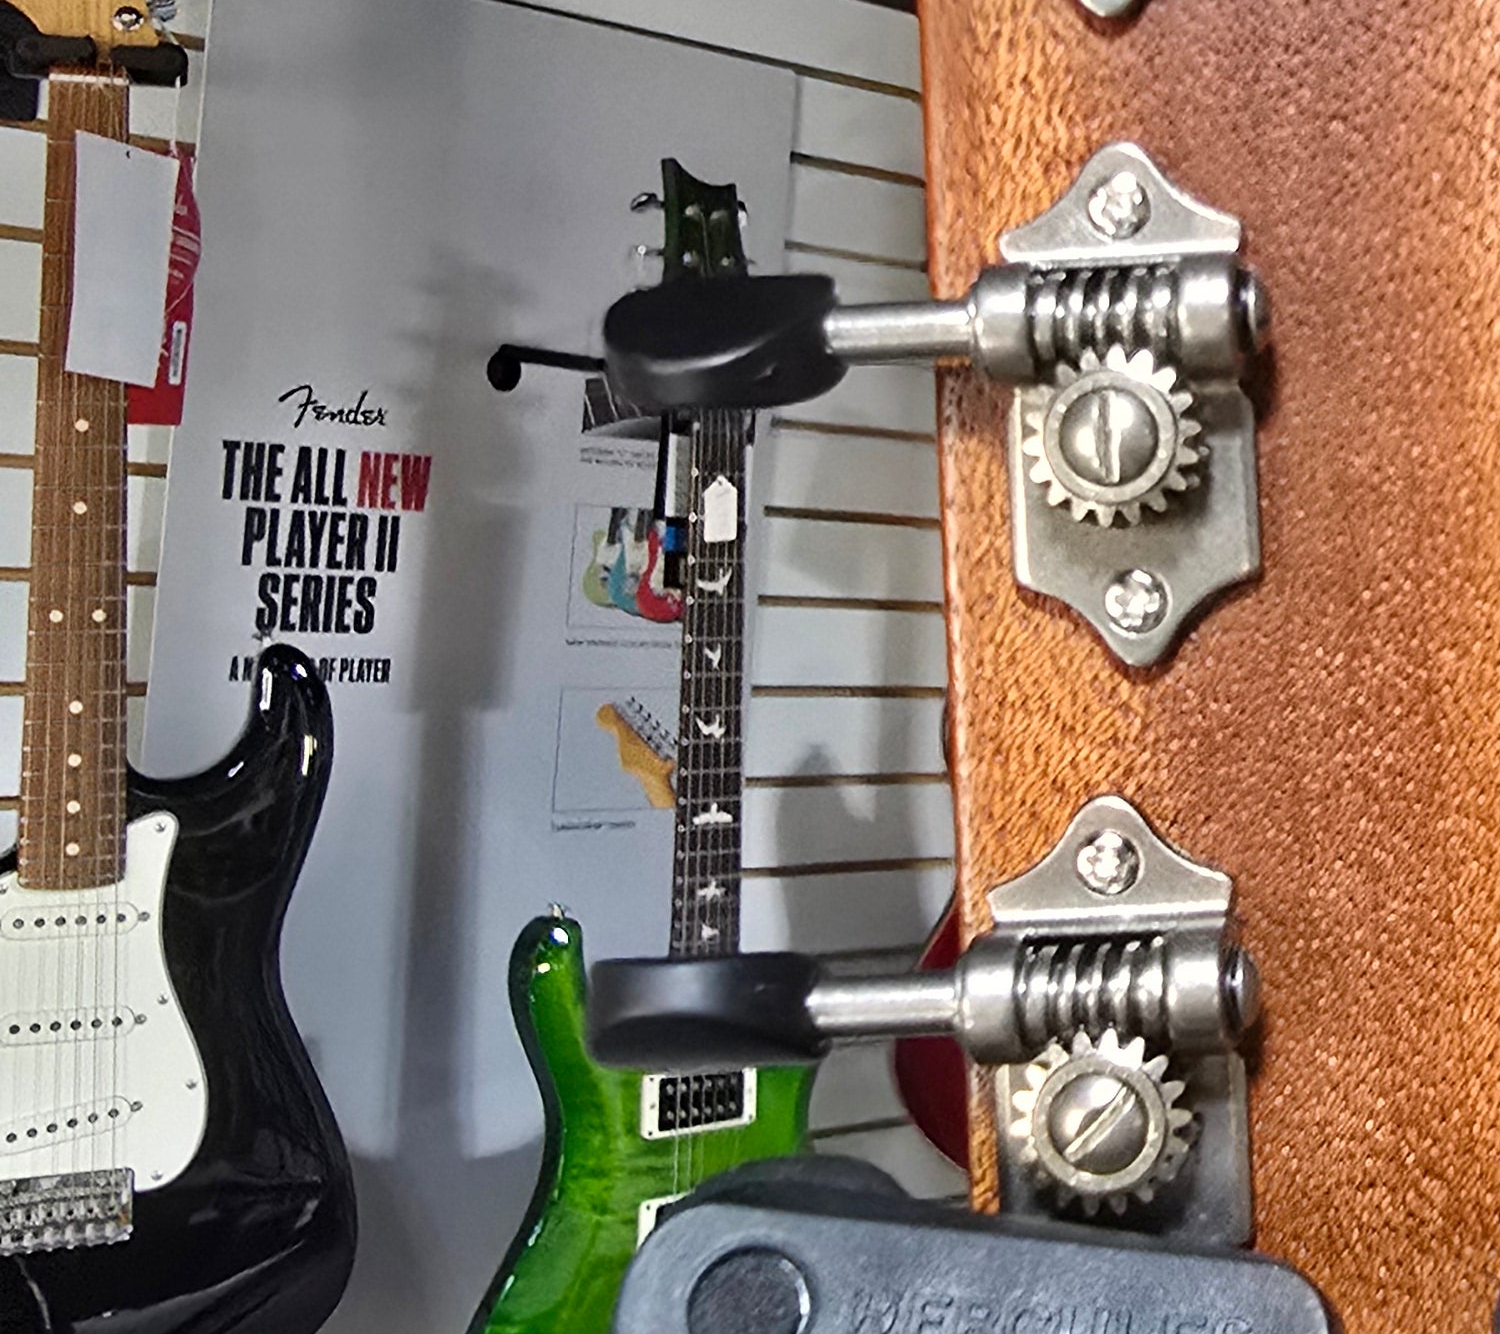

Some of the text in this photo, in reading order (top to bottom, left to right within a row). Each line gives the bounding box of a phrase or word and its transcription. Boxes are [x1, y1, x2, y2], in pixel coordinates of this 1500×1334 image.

[278, 384, 388, 428] Fender
[222, 439, 433, 512] THE ALL NEW
[241, 506, 400, 573] PLAYER II
[255, 572, 377, 635] SERIES
[228, 655, 240, 682] A
[338, 658, 392, 684] PLAYER
